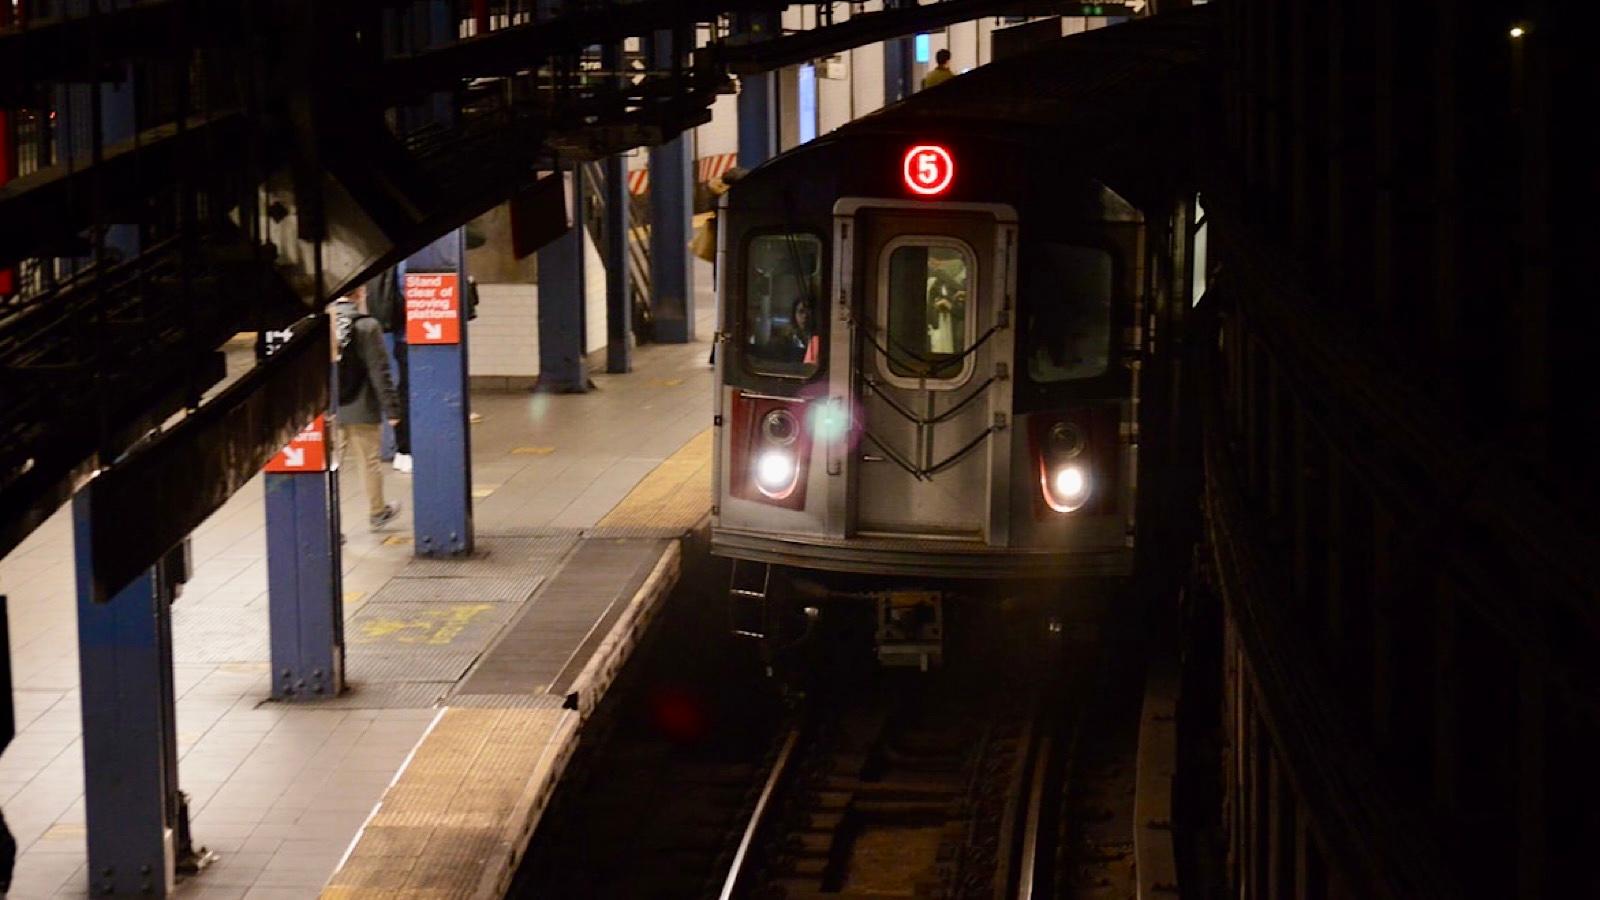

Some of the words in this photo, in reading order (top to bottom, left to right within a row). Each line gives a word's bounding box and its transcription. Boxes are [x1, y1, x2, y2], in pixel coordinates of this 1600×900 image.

[919, 154, 938, 184] 5
[407, 276, 442, 288] Stand
[407, 288, 435, 297] clear
[440, 286, 454, 297] of
[407, 298, 450, 310] moving
[407, 310, 457, 322] platform
